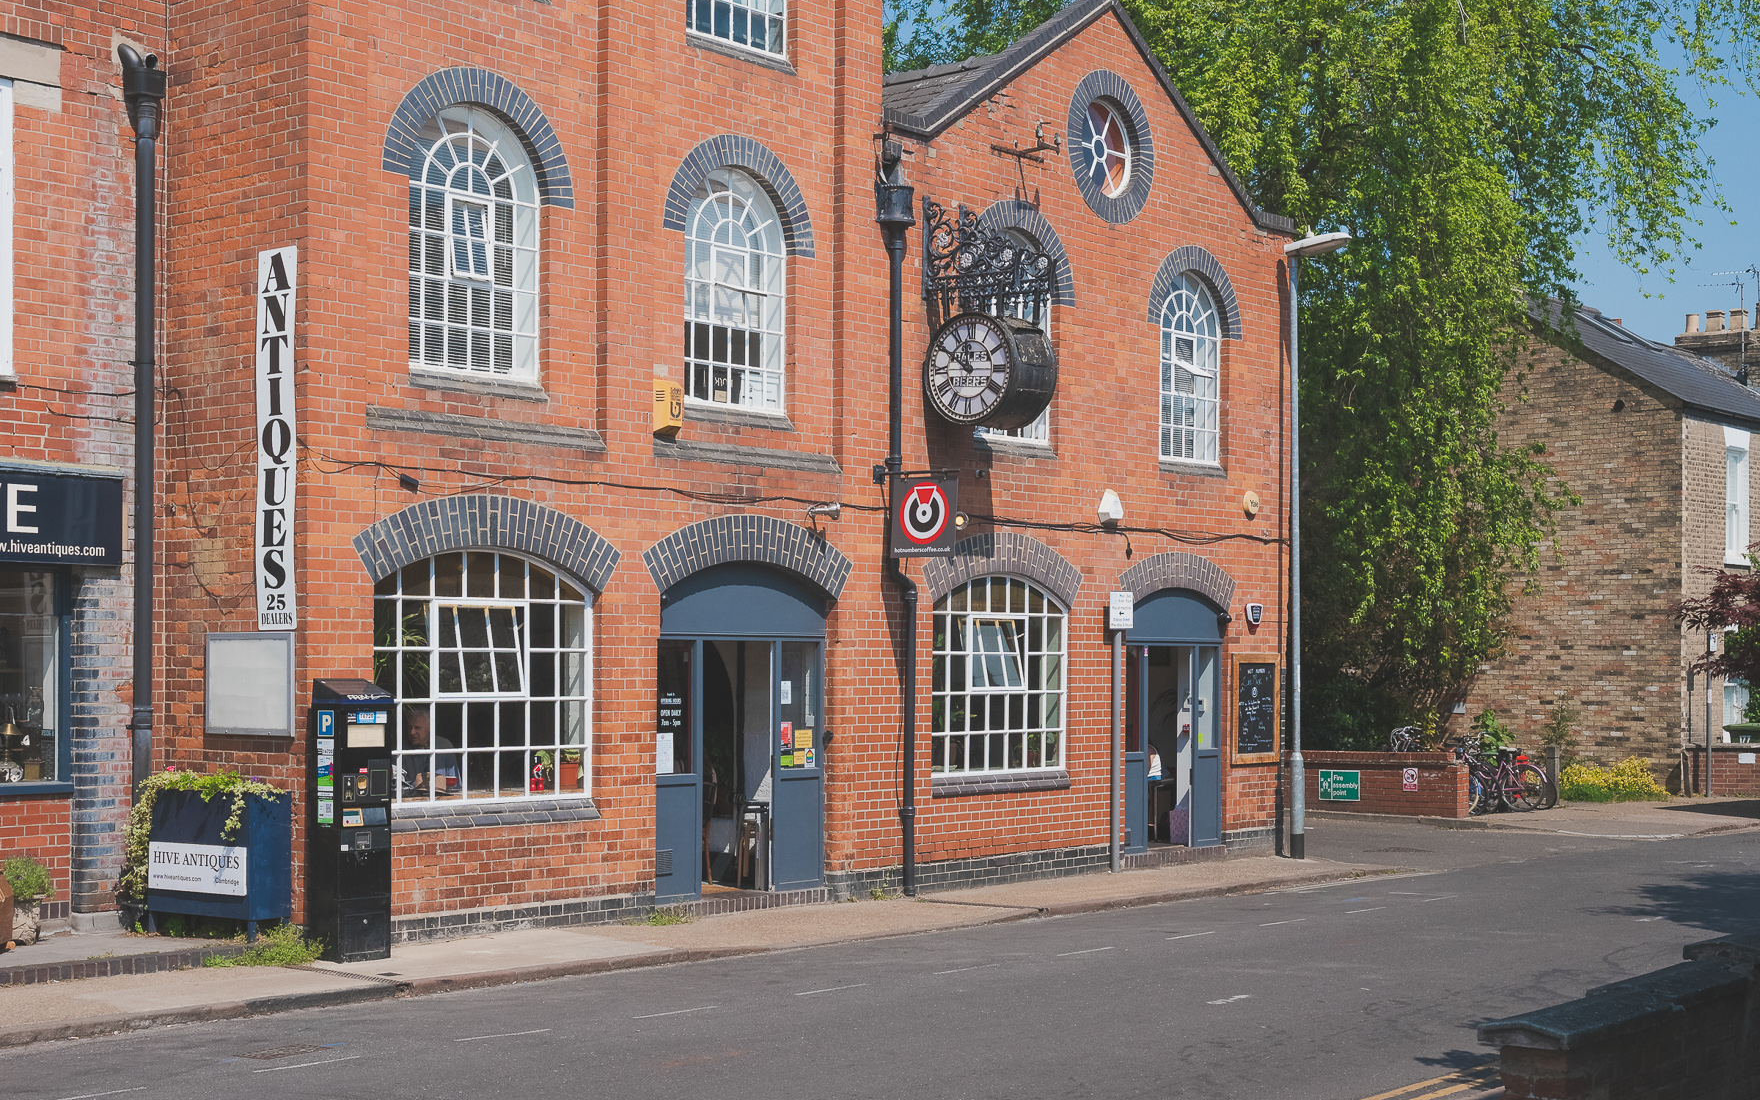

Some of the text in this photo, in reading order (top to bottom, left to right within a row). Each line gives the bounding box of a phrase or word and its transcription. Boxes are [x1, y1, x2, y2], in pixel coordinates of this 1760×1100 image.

[261, 252, 292, 590] ANTIQUES
[0, 483, 39, 534] E
[894, 545, 951, 554] hotnumberscoffee.co.uk
[266, 593, 286, 611] 25
[261, 612, 293, 625] DEALERS
[660, 709, 670, 717] OPEN
[322, 714, 332, 733] P
[1332, 782, 1358, 790] assembly
[153, 850, 240, 873] HIVE ANTIQUES
[153, 873, 240, 886] www.hiveantiques.com Cambridge
